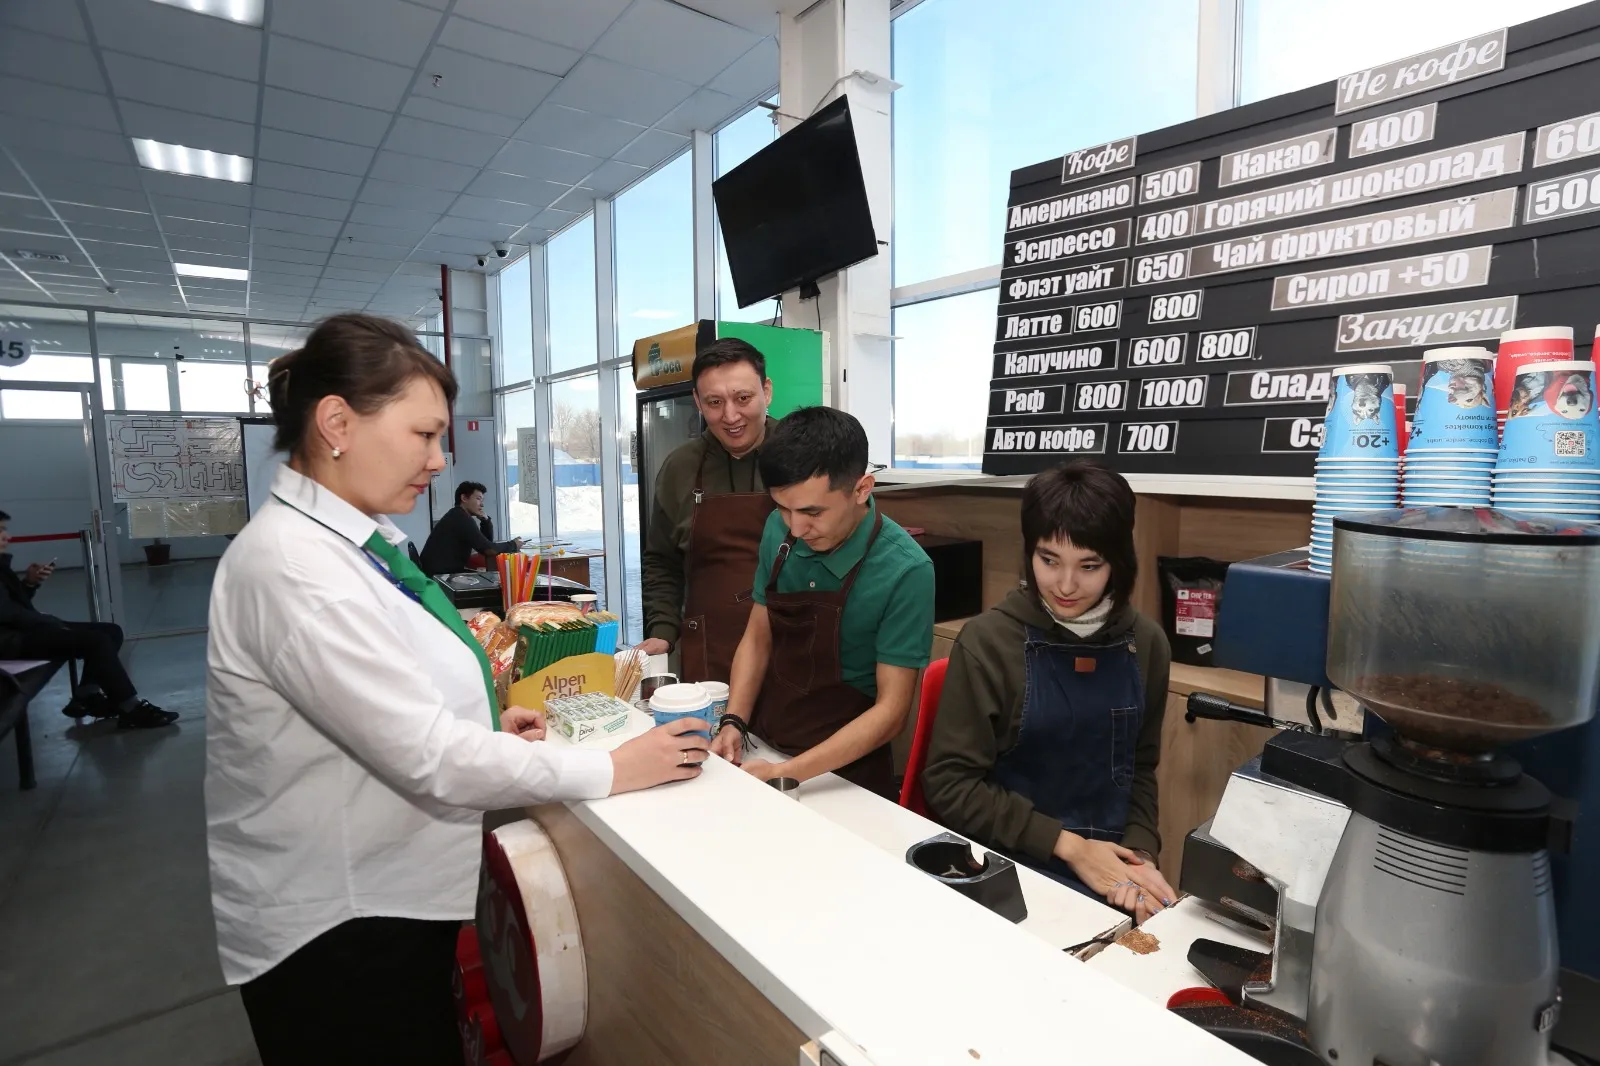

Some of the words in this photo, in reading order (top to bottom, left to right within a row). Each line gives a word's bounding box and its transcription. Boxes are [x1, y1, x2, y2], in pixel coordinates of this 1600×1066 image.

[1340, 68, 1386, 104] Не
[1393, 39, 1500, 90] кофе
[1067, 143, 1129, 175] Кофе
[1232, 139, 1320, 182] Какао
[1357, 110, 1425, 152] 400
[1009, 182, 1130, 230] Американо
[1144, 166, 1194, 200] 500
[1203, 178, 1324, 230] Горячий
[1331, 143, 1505, 201] шоколад
[1014, 226, 1116, 264] Эспрессо
[1141, 209, 1189, 241] 400
[1212, 235, 1265, 270] Чай
[1270, 197, 1475, 261] фруктовый
[1008, 276, 1062, 300] Флэт
[1064, 264, 1114, 295] уайт
[1136, 252, 1185, 284] 650
[1286, 267, 1390, 304] Сироп
[1398, 252, 1469, 288] +50
[1004, 314, 1062, 339] Латте
[1077, 303, 1116, 329] 600
[1152, 293, 1196, 321] 800
[1339, 305, 1511, 346] Закуски
[1004, 346, 1102, 376] Капучино
[1133, 336, 1181, 365] 600
[1200, 331, 1249, 359] 800
[1004, 389, 1045, 413] Раф
[1078, 383, 1122, 410] 800
[1143, 377, 1204, 406] 1000
[992, 428, 1036, 451] Авто
[1039, 426, 1095, 452] кофе
[1126, 424, 1169, 451] 700
[1356, 434, 1390, 448] +20
[542, 673, 586, 693] Alpen
